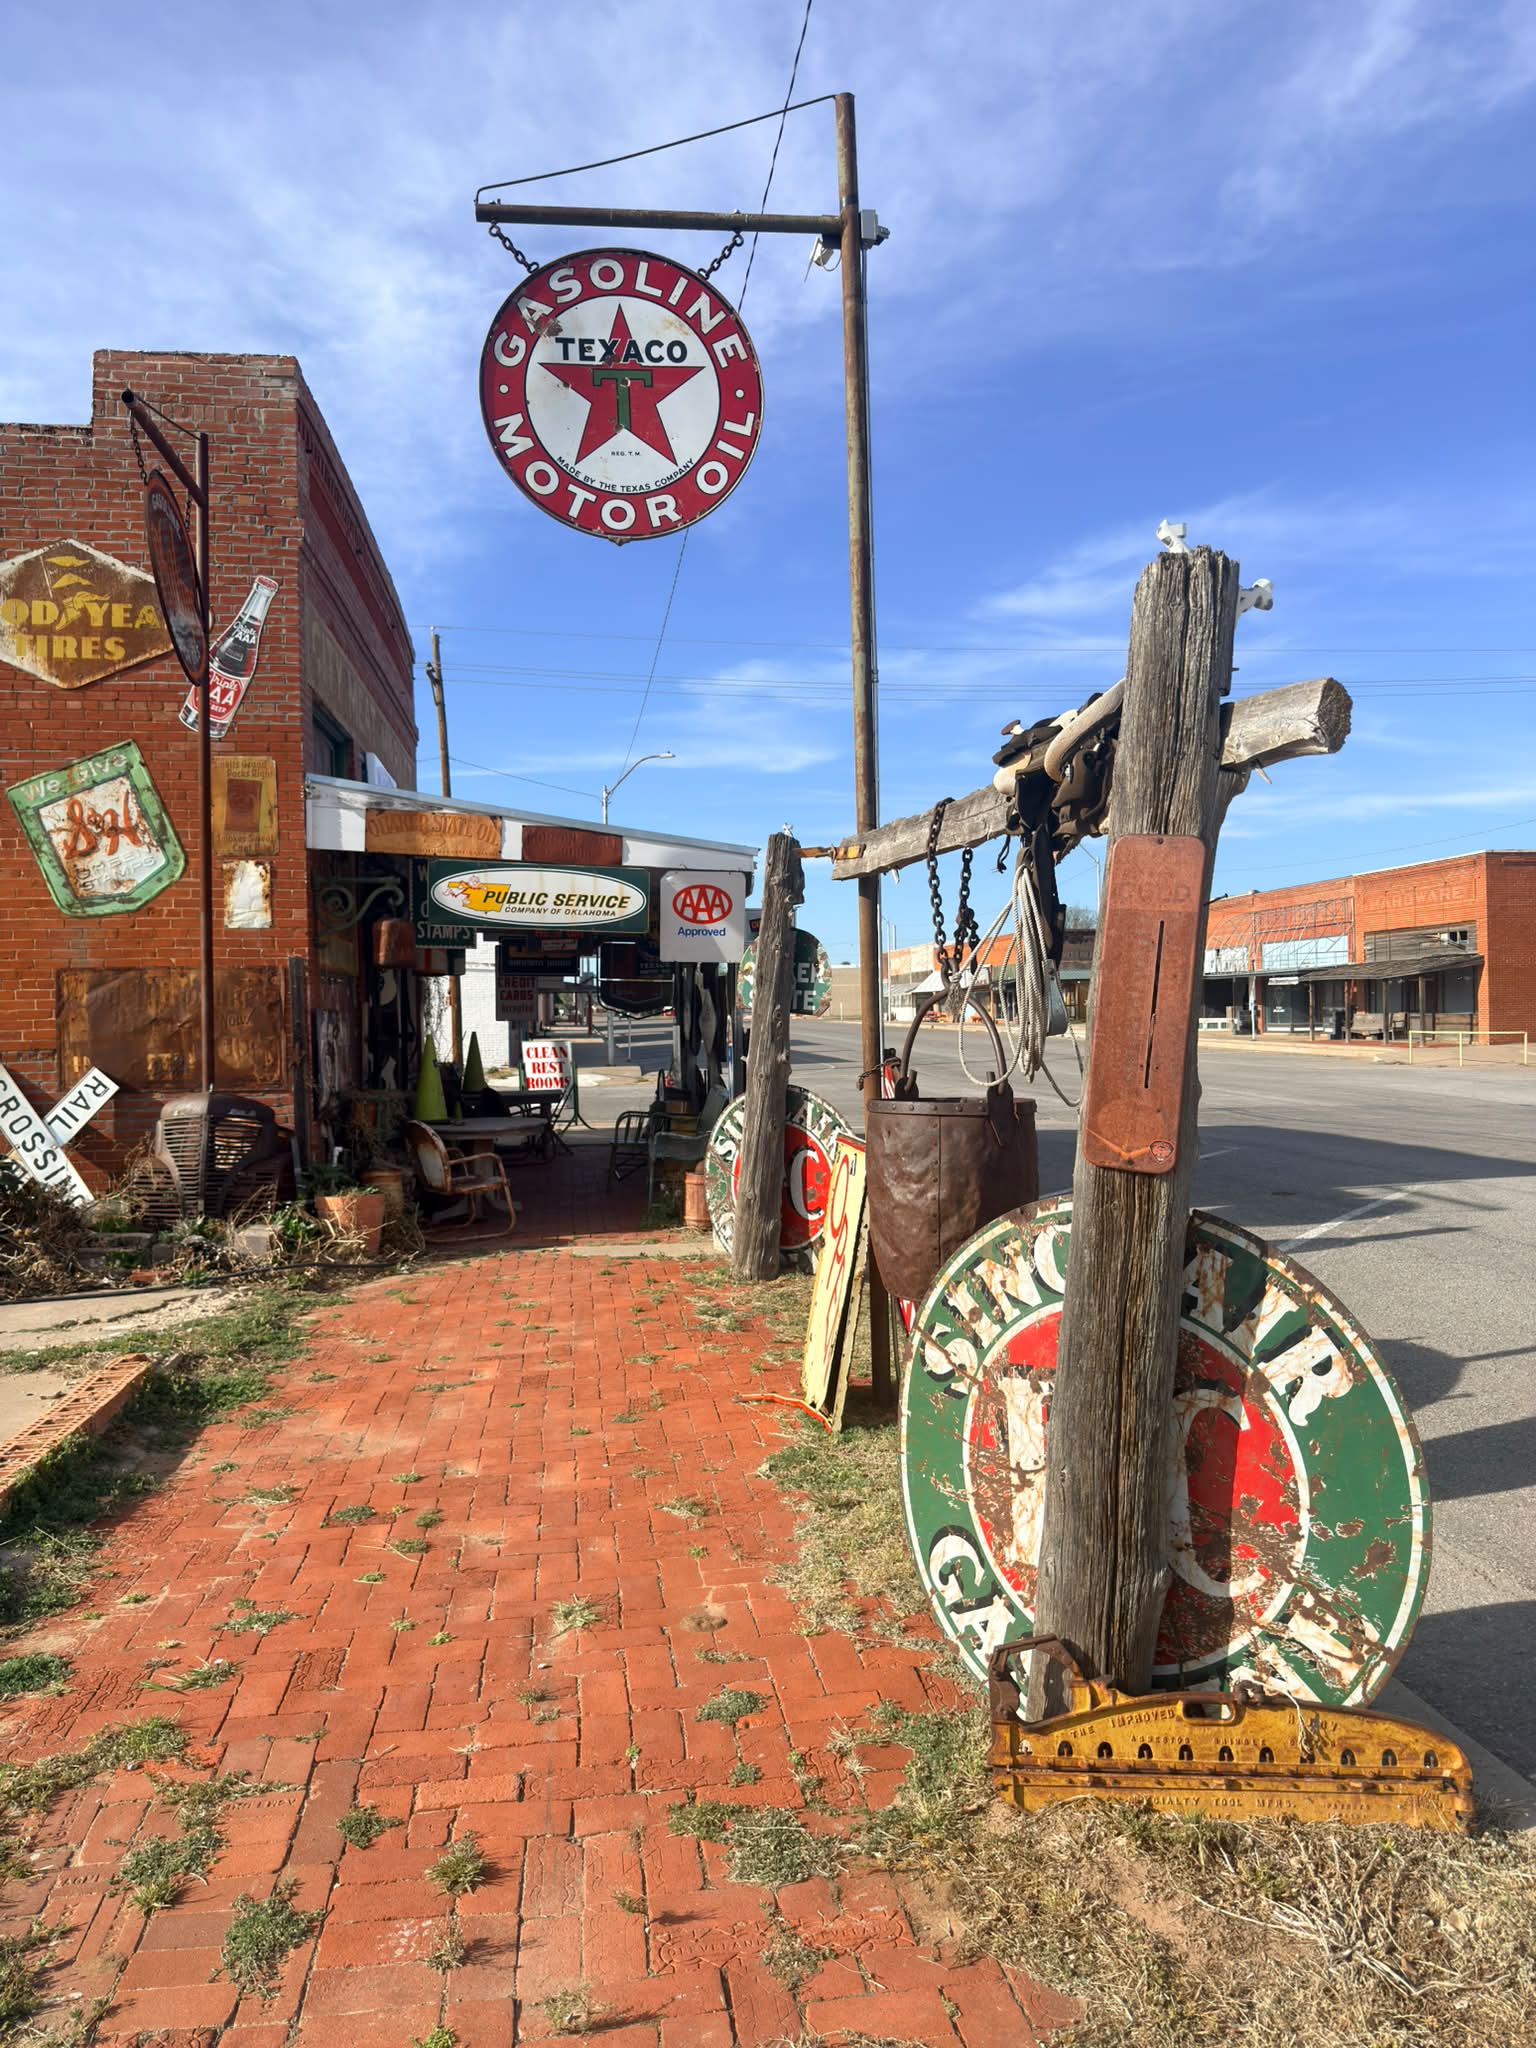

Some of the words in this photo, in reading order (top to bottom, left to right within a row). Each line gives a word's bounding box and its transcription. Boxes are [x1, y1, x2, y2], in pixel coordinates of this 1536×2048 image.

[493, 257, 748, 369] GASOLINE
[555, 336, 688, 364] TEXACO
[493, 412, 682, 531] MOTOR
[695, 411, 755, 496] OIL
[556, 456, 582, 478] MADE
[583, 475, 596, 485] BY
[600, 481, 617, 492] THE
[620, 483, 651, 493] TEXAS
[654, 457, 694, 488] COMPANY
[10, 633, 126, 661] TIRES
[234, 630, 257, 645] AAA
[209, 686, 235, 707] AA
[21, 778, 61, 801] We
[483, 890, 549, 905] PUBLIC
[553, 893, 631, 909] SERVICE
[677, 885, 729, 923] AAA
[504, 906, 549, 915] COMPANY
[550, 907, 562, 916] OF
[564, 908, 616, 917] OKLAHOMA
[416, 920, 470, 940] STAMPS
[677, 926, 726, 938] Approved
[497, 976, 537, 988] CREDIT
[500, 990, 534, 1001] CARDS
[526, 1046, 568, 1059] CLEAN
[531, 1062, 566, 1074] REST
[525, 1076, 571, 1089] ROOMS
[47, 1075, 110, 1130] RAIL
[1070, 1725, 1097, 1739] THE
[1110, 1708, 1176, 1729] IMPROVED
[1214, 1797, 1243, 1808] TOOL
